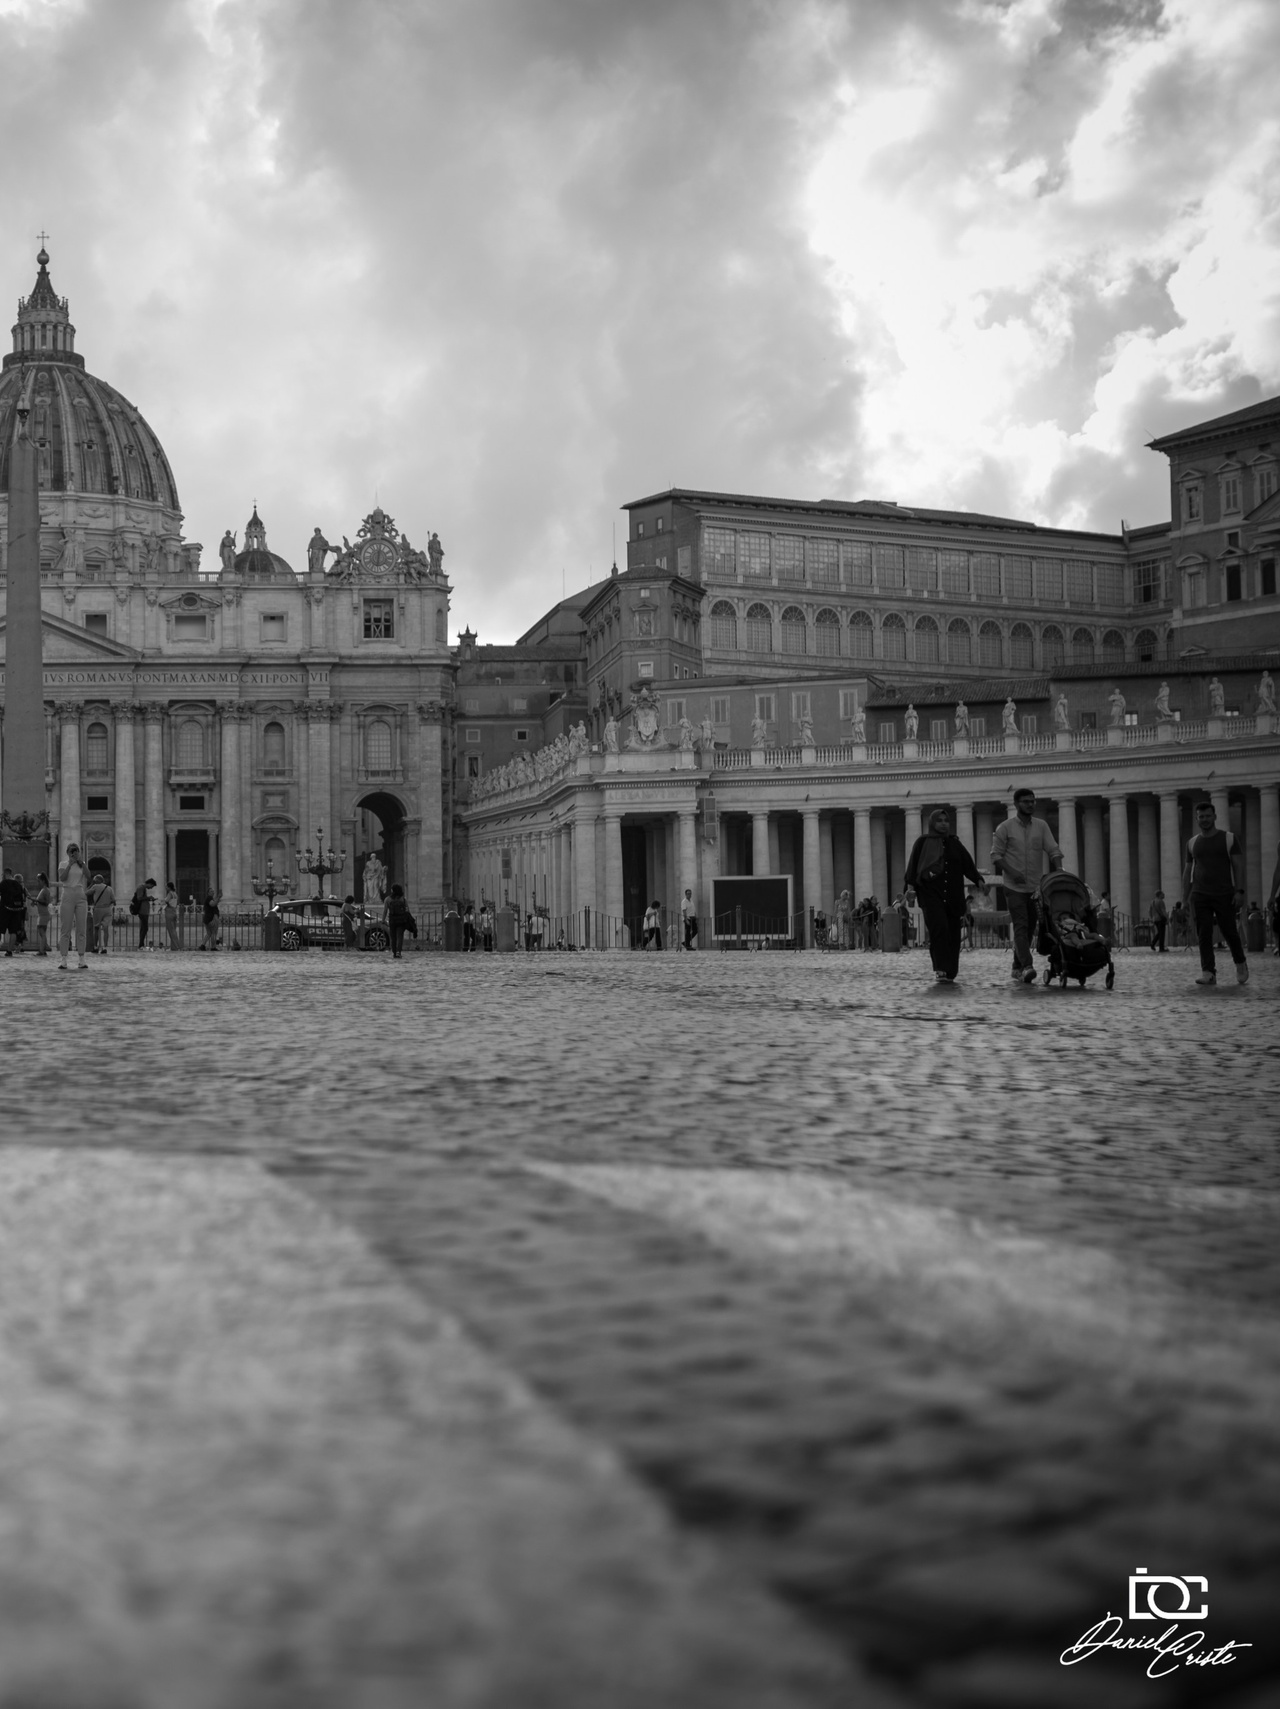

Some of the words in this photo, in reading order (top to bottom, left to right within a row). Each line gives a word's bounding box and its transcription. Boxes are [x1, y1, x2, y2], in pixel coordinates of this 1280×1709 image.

[67, 672, 132, 683] ROMANVS
[273, 673, 307, 684] PONT
[310, 672, 328, 682] VII
